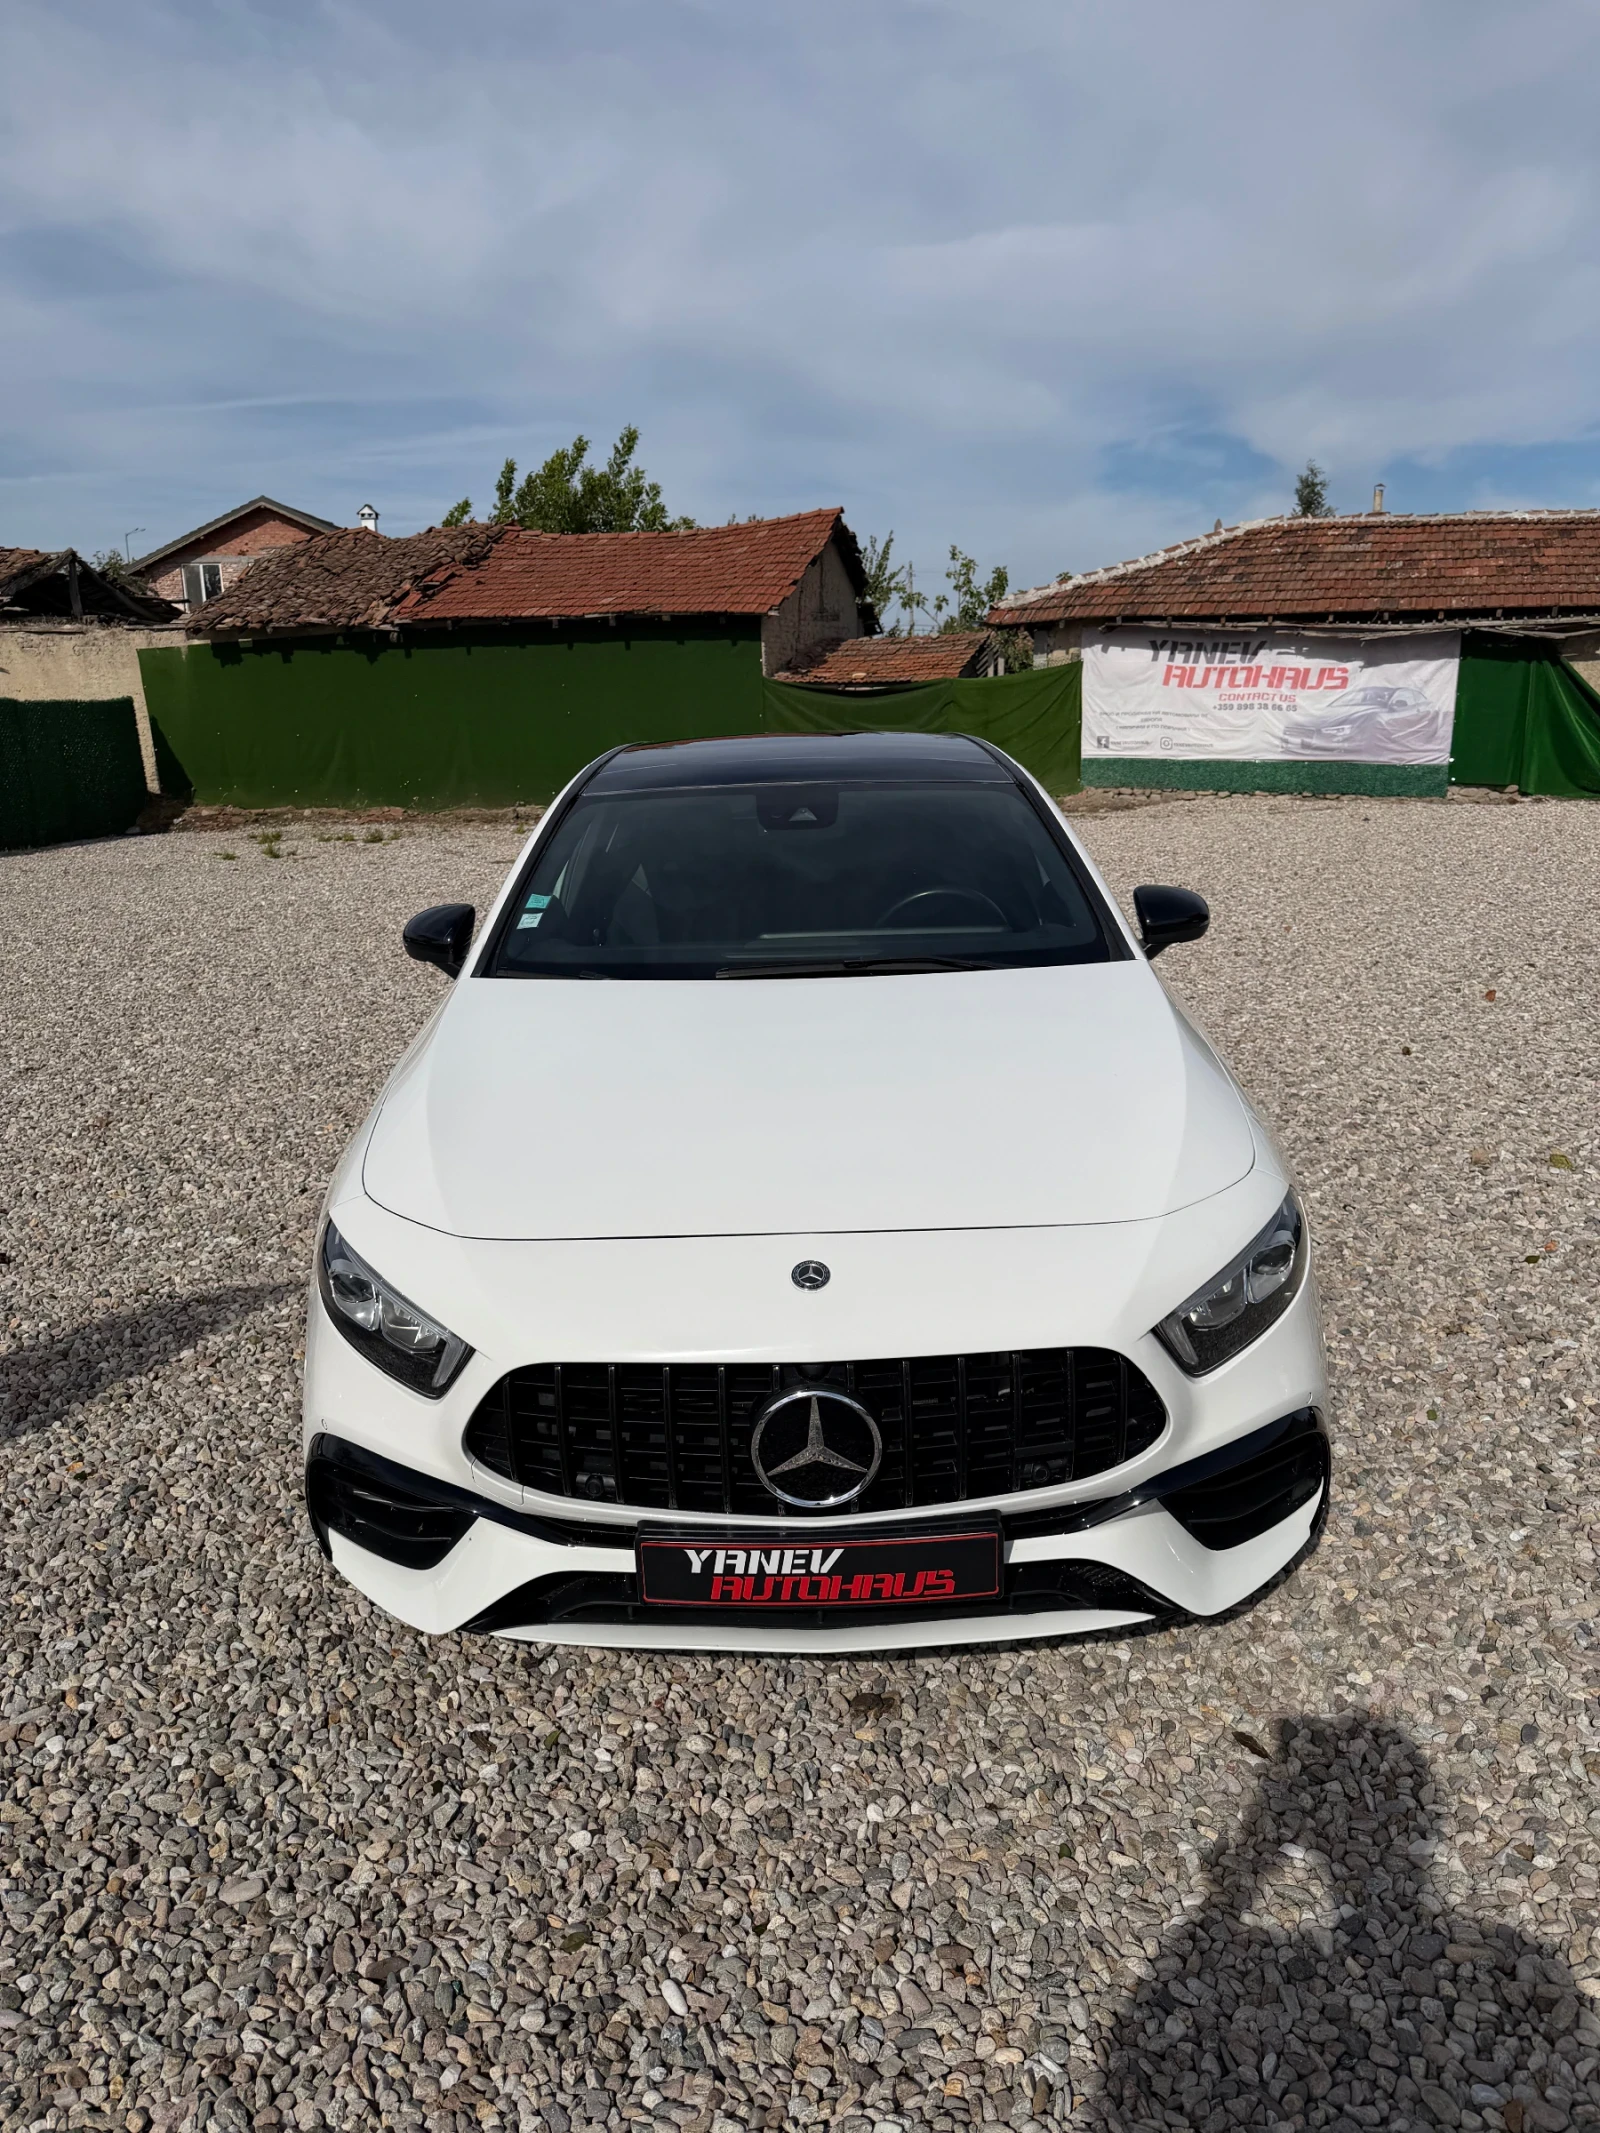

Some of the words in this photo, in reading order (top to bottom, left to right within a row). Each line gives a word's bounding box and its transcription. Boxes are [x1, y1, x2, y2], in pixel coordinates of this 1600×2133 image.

[1149, 640, 1268, 664] YANEV
[1162, 665, 1349, 690] AUTOHAUS
[1213, 703, 1234, 711] +359
[1236, 703, 1255, 711] 898
[1218, 692, 1277, 702] CONTACT
[1279, 694, 1297, 703] US
[684, 1549, 845, 1574] YANEV
[711, 1569, 955, 1600] AUTOHAUS
